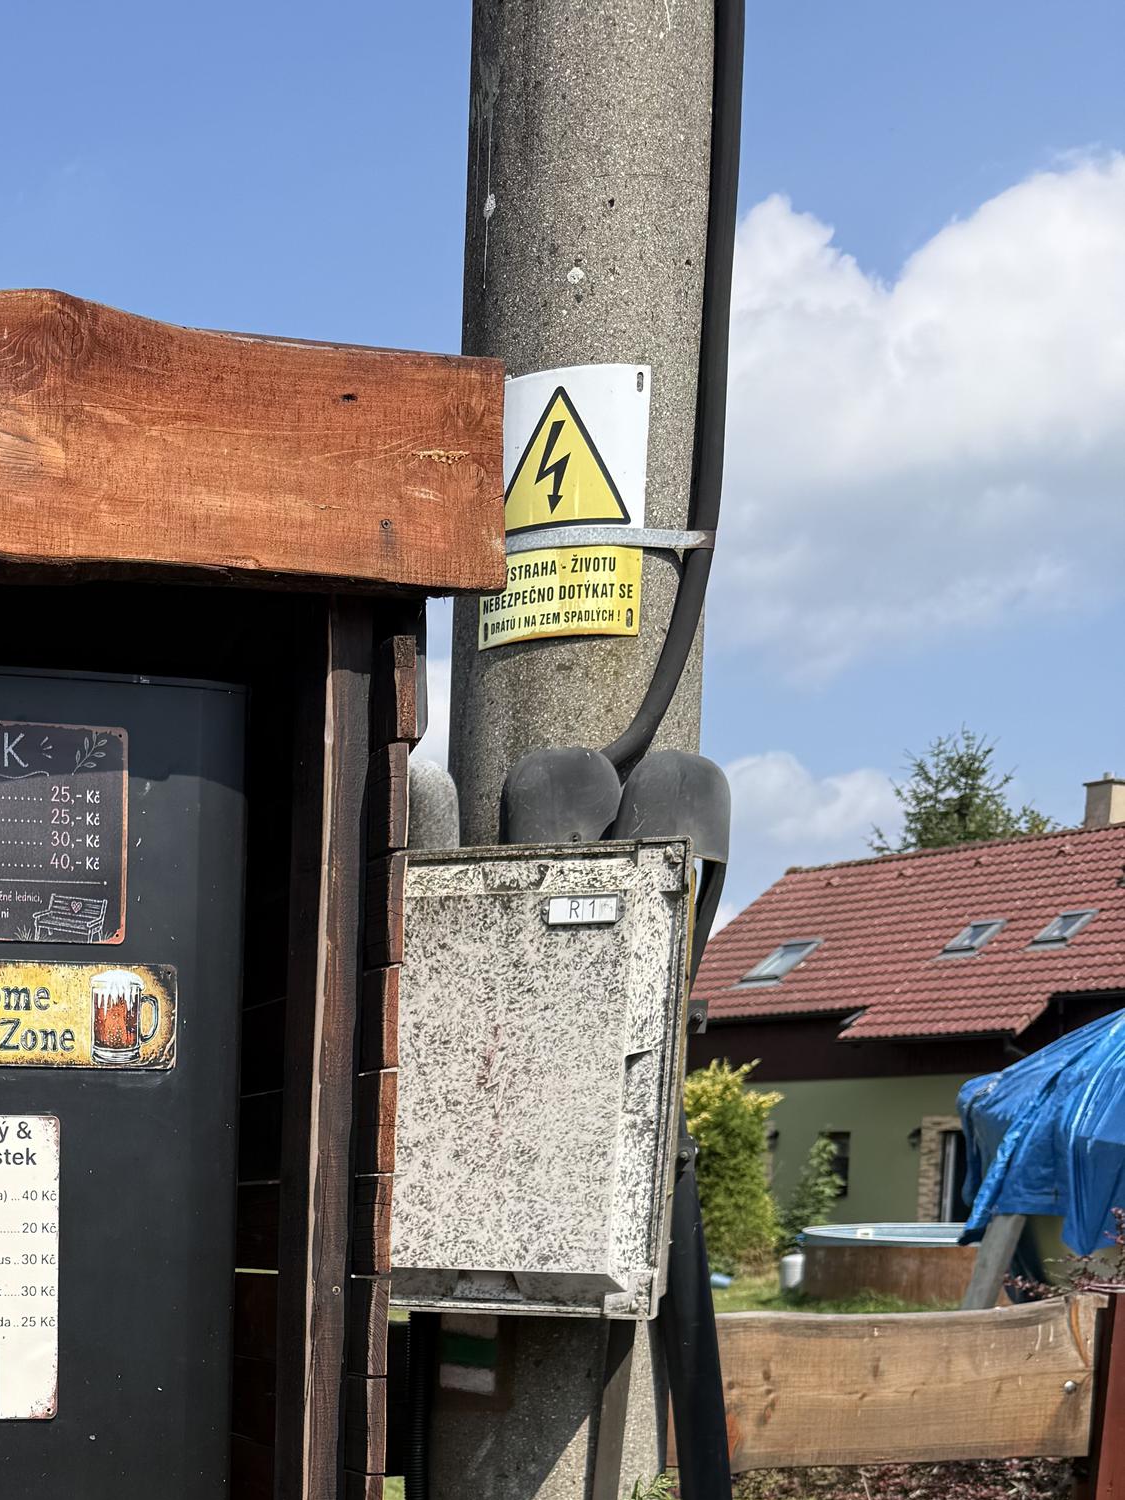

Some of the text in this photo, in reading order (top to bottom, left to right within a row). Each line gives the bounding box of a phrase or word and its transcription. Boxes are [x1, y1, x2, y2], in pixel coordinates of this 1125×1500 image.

[507, 560, 557, 581] STRAHA
[571, 554, 617, 573] ŽIVOTU
[483, 580, 634, 615] NEBEZPEČNO DOTÝKAT SE
[518, 617, 522, 629] I
[524, 614, 537, 628] NA
[539, 611, 561, 625] ZEM
[563, 607, 614, 624] SPADLÝCH
[50, 785, 82, 804] 25,-
[86, 789, 101, 804] Kč
[50, 808, 82, 827] 25,-
[86, 812, 101, 826] Kč
[50, 830, 82, 848] 30,-
[86, 834, 101, 848] Kč
[49, 852, 82, 871] 40,-
[86, 856, 101, 871] Kč
[0, 1017, 77, 1052] Zone
[16, 1121, 33, 1139] &
[22, 1190, 38, 1201] 40
[41, 1190, 57, 1201] Kč
[22, 1222, 38, 1234] 20
[41, 1222, 57, 1234] Kč
[21, 1254, 38, 1265] 30
[41, 1254, 56, 1265] Kč
[21, 1285, 37, 1297] 30
[41, 1285, 56, 1297] Kč
[21, 1316, 37, 1327] 25
[40, 1316, 56, 1327] Kč
